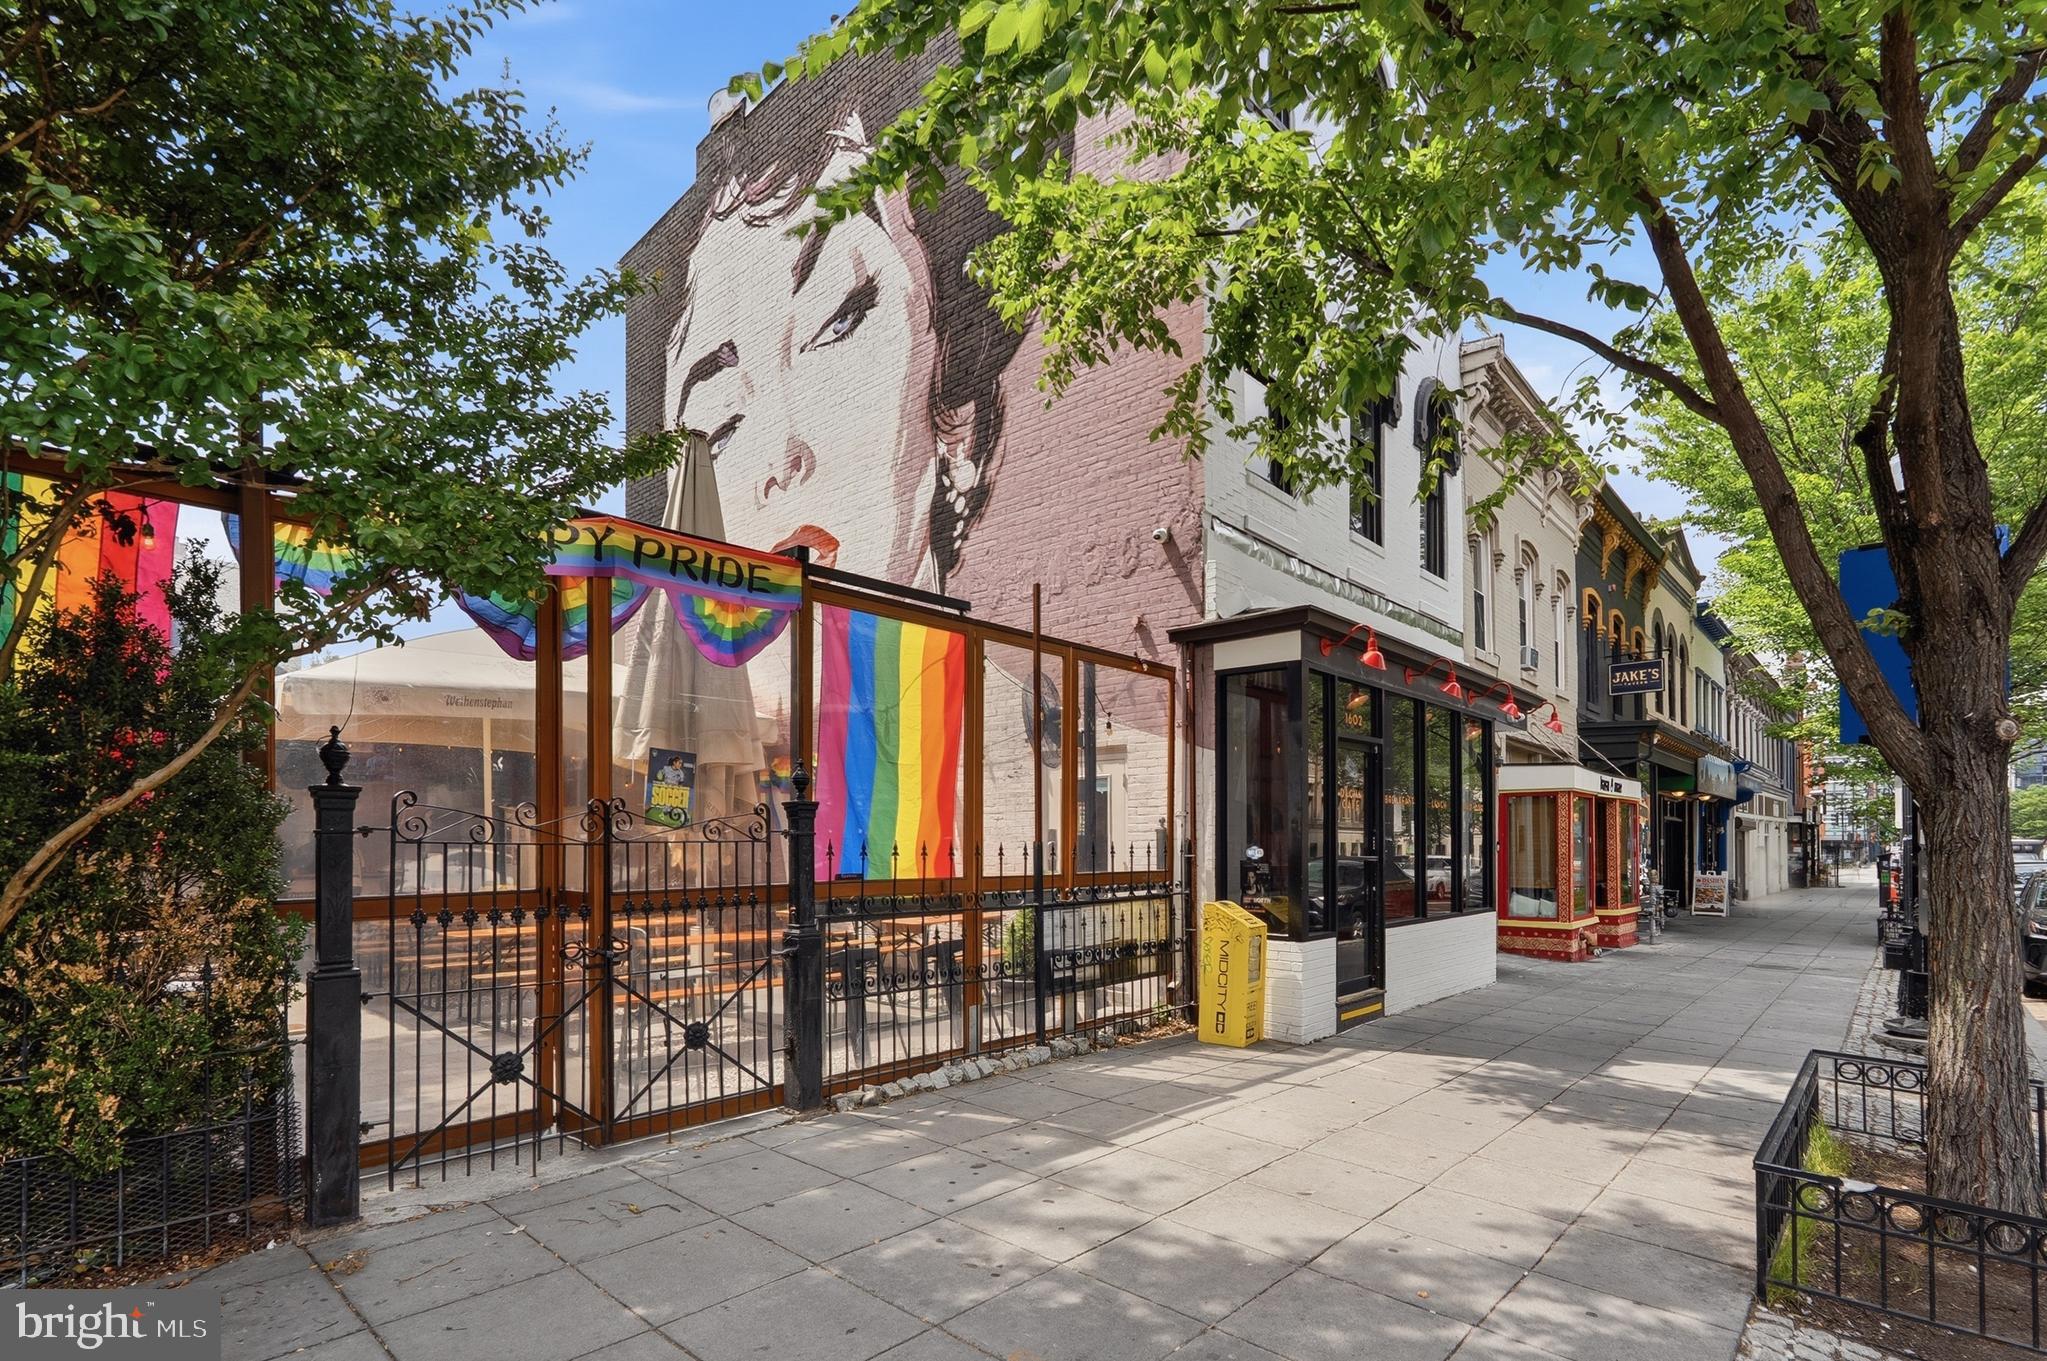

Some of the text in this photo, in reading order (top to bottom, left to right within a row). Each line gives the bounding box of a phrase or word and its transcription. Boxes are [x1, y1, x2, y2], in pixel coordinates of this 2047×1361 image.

[633, 534, 772, 594] PRIDE
[1612, 668, 1660, 683] JAKE'S
[444, 694, 513, 710] Weihenstephan
[1344, 712, 1363, 727] 1602
[651, 785, 690, 809] SOCCER
